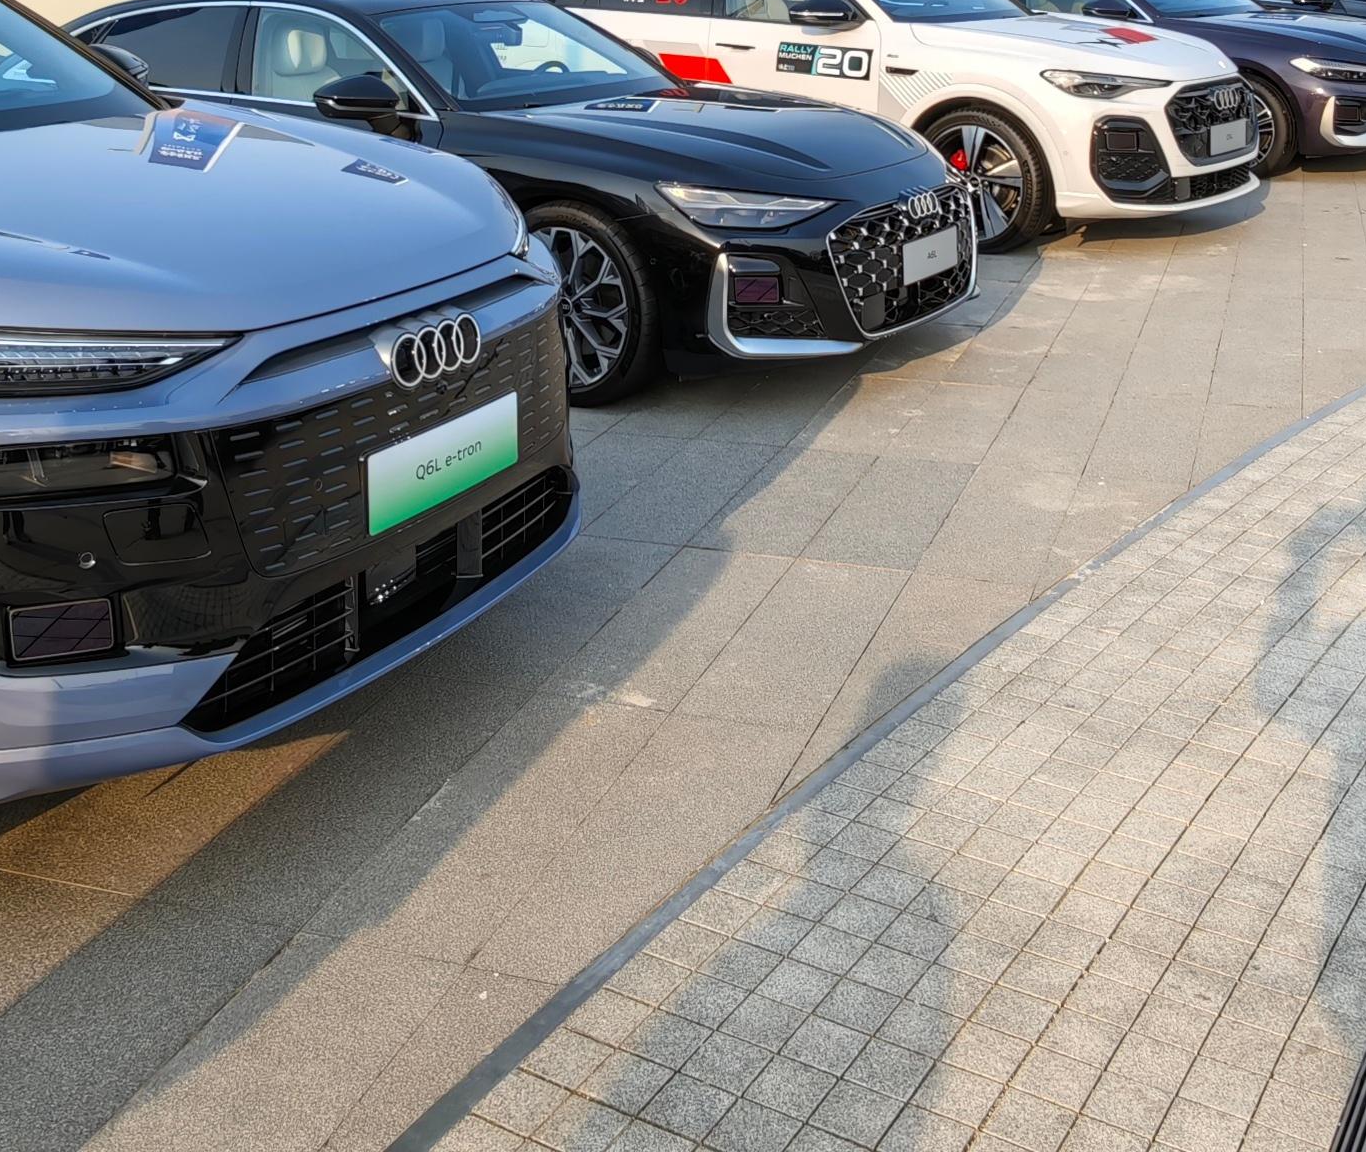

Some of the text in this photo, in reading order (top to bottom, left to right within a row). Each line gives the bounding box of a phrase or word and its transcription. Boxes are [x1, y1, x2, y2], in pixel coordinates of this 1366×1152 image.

[778, 52, 813, 61] MUCHEN
[779, 44, 814, 54] RALLY
[816, 48, 870, 78] 20
[416, 441, 482, 480] Q6L e-tron
